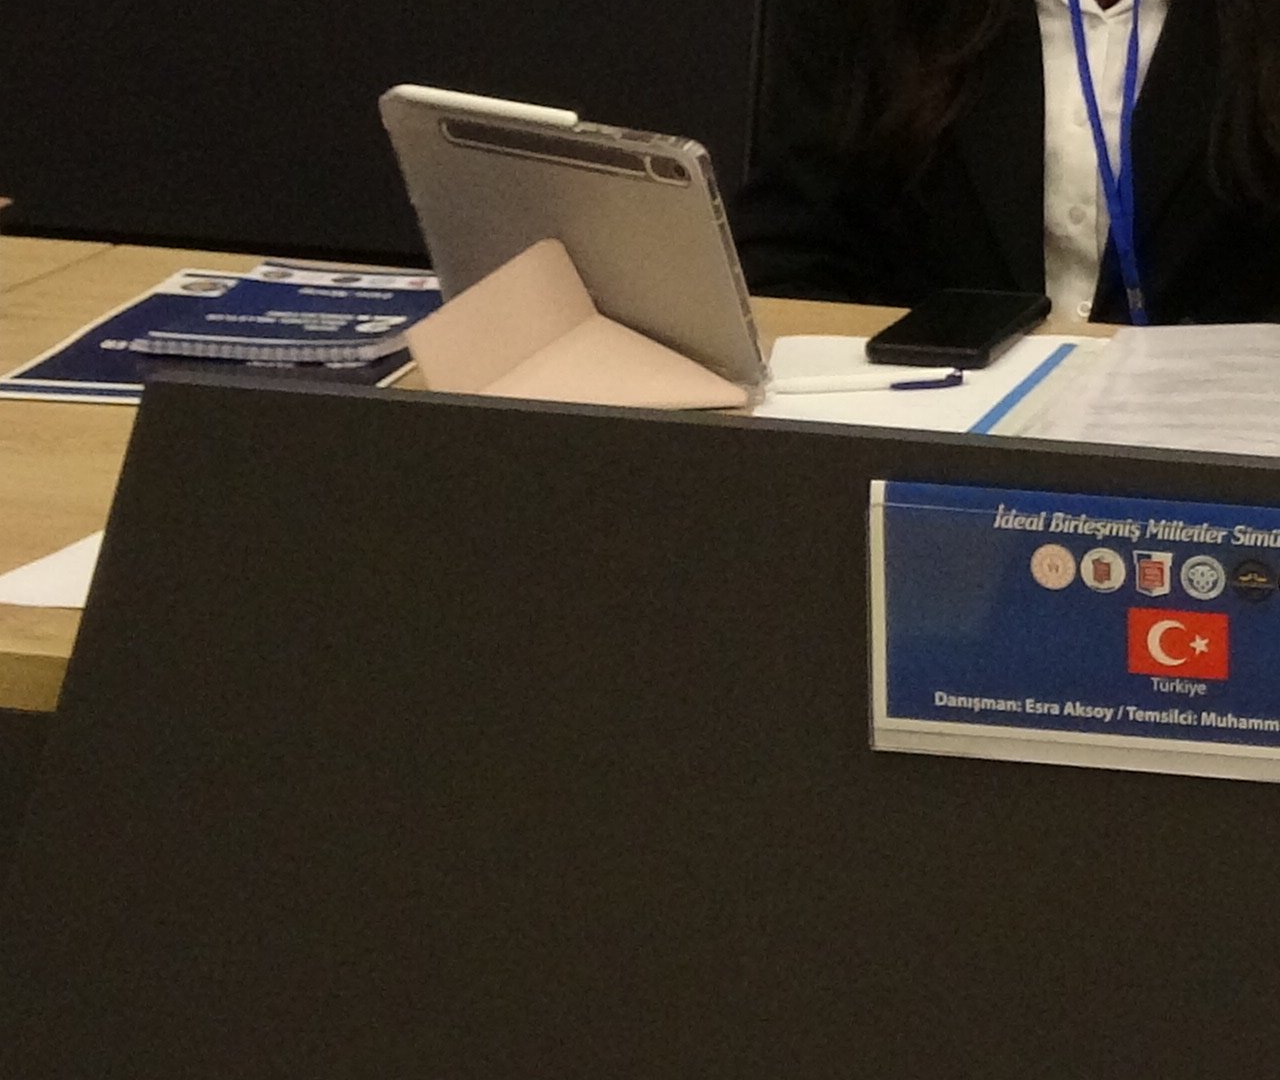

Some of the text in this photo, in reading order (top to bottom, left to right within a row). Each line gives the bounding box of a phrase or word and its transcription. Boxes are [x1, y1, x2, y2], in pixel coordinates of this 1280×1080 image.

[993, 503, 1046, 532] İdeal
[1048, 512, 1142, 542] Birleşmiş
[1145, 518, 1228, 545] Milletler
[1151, 677, 1207, 698] Türkiye
[934, 691, 1022, 712] Danışman:
[1025, 698, 1060, 715] Esra
[1063, 701, 1114, 722] Aksoy
[1126, 706, 1198, 726] Temsilci:
